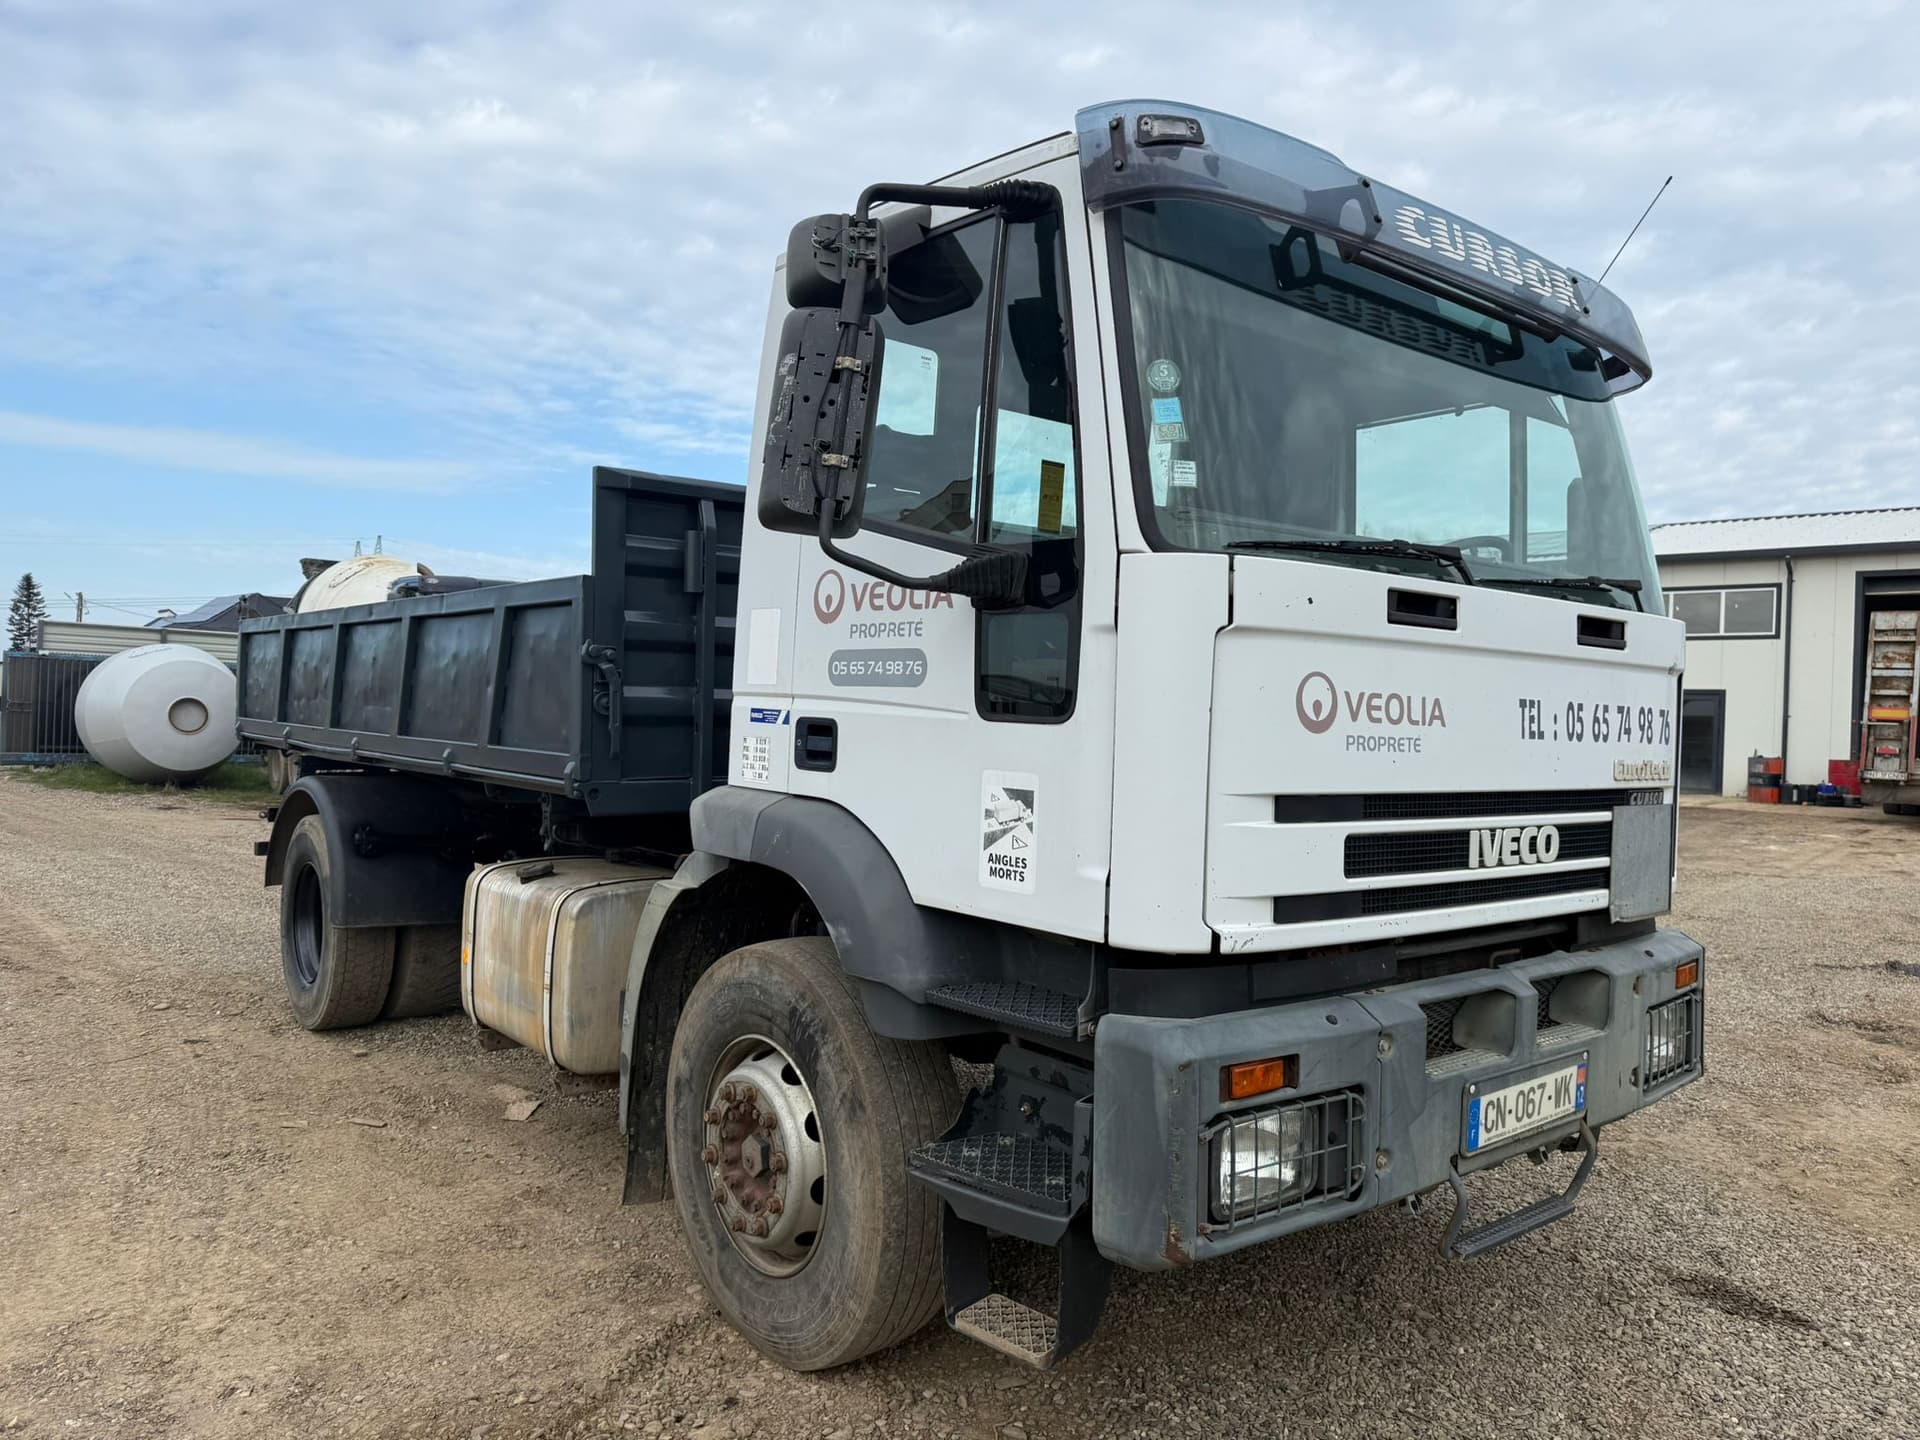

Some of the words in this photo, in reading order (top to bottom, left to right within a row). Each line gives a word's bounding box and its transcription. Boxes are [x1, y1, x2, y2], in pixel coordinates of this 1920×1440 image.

[1393, 205, 1581, 312] CURSOR
[851, 581, 953, 611] VEOLIA
[850, 618, 923, 639] PROPRETÉ
[832, 661, 847, 675] 05
[850, 661, 865, 675] 65
[867, 661, 883, 675] 74
[886, 661, 902, 675] 98
[905, 660, 922, 675] 76
[1344, 690, 1446, 728] VEOLIA
[1519, 698, 1544, 740] TEL
[1566, 701, 1584, 743] 05
[1592, 703, 1609, 743] 65
[1617, 705, 1631, 743] 74
[1638, 706, 1653, 745] 98
[1659, 709, 1670, 746] 76
[988, 852, 1028, 870] ANGLES
[1468, 825, 1560, 869] IVECO
[989, 865, 1025, 882] MORTS
[1484, 1073, 1573, 1134] CN-067-WK
[1471, 1129, 1476, 1141] F
